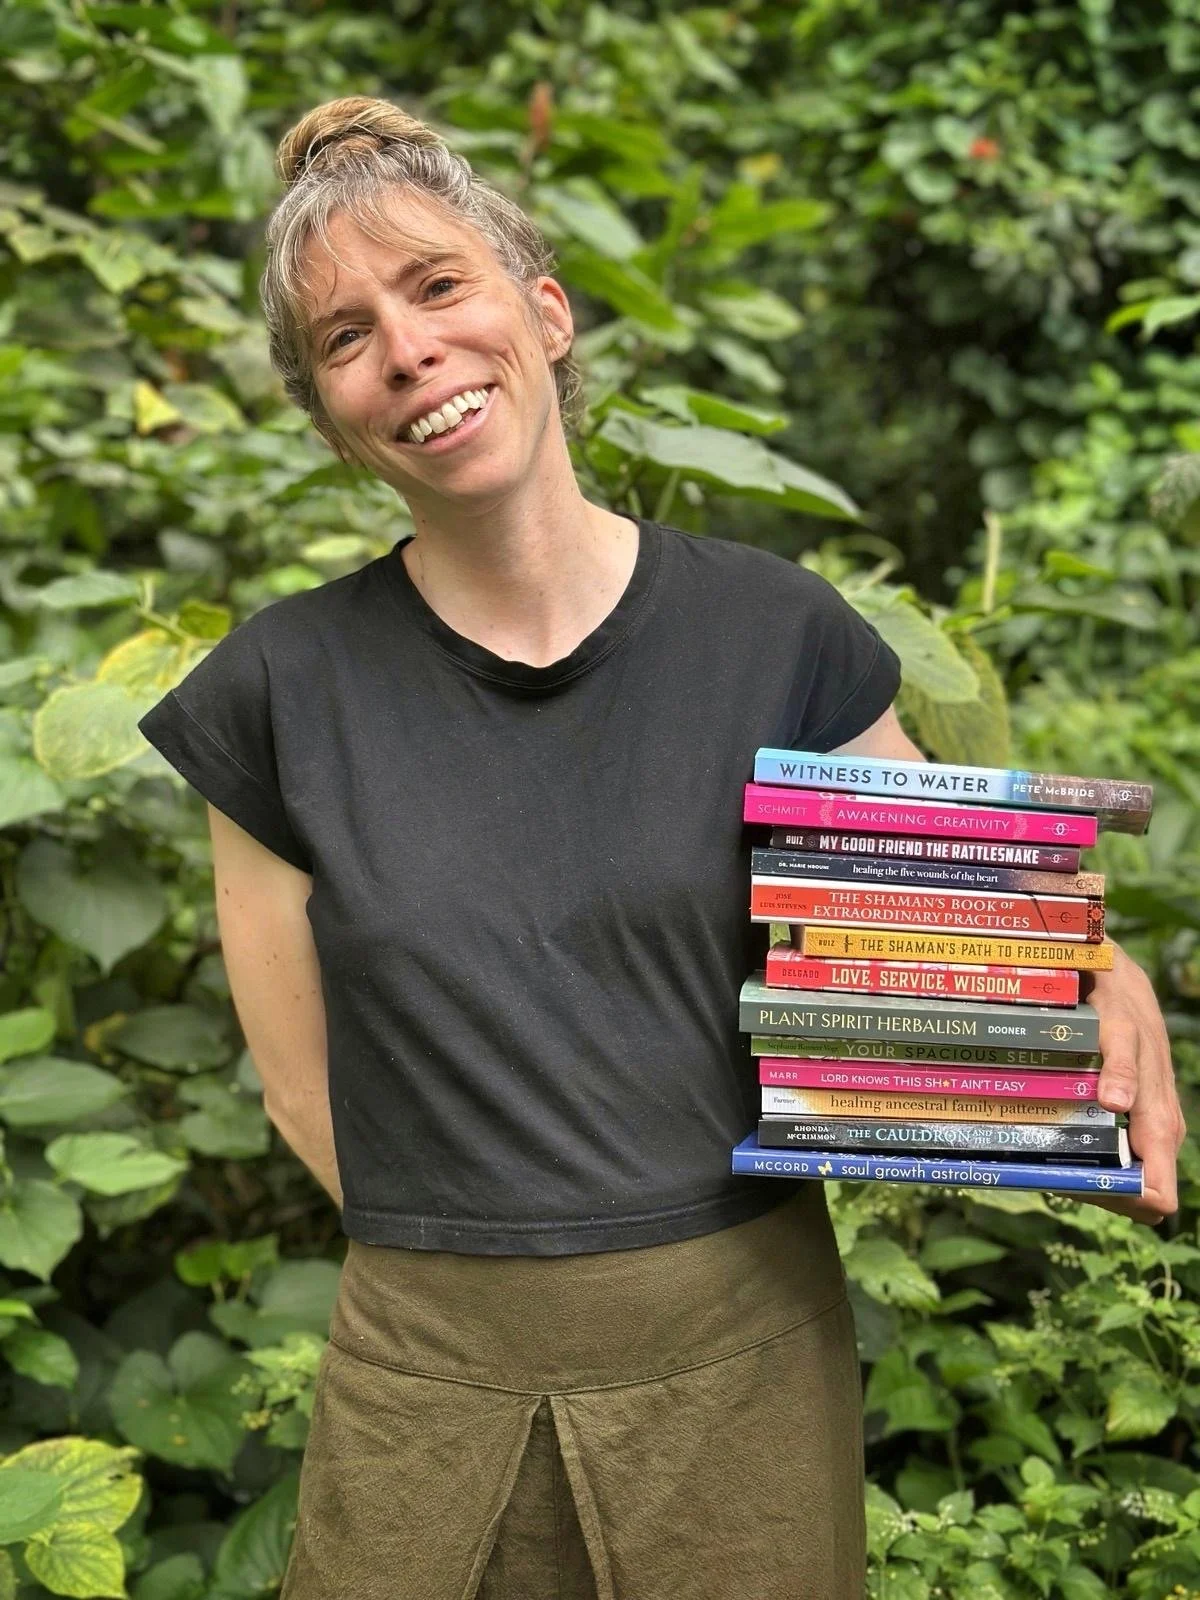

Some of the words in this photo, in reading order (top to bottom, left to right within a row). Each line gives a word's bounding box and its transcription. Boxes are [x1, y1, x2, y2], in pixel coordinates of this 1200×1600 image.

[780, 763, 871, 784] WITNESS
[882, 771, 907, 786] TO
[919, 774, 988, 793] WATER
[1013, 783, 1040, 794] PETE
[1045, 786, 1095, 798] McBRIDE
[758, 804, 808, 816] SCHMITT
[836, 809, 926, 826] AWAKENING
[934, 815, 1010, 830] CREATIVITY
[786, 835, 804, 845] RUIZ
[820, 835, 837, 850] MY
[841, 837, 875, 853] GOOD
[879, 839, 922, 856] FRIEND
[926, 842, 949, 858] THE
[951, 844, 1040, 865] RATTLESNAKE
[852, 864, 884, 877] healing
[885, 867, 899, 877] the
[900, 867, 916, 877] five
[917, 869, 949, 880] wounds
[950, 871, 962, 880] of
[961, 871, 975, 881] the
[976, 873, 999, 883] heart
[829, 891, 860, 904] THE
[864, 894, 945, 910] SHAMAN'S
[951, 898, 997, 912] BOOK
[1001, 901, 1015, 910] OF
[813, 905, 943, 924] EXTRAORDINARY
[944, 913, 1030, 928] PRACTICES
[818, 939, 835, 947] RUIZ
[861, 938, 884, 951] THE
[889, 940, 956, 955] SHAMAN'S
[961, 943, 992, 957] PATH
[998, 945, 1012, 958] TO
[1017, 946, 1074, 960] FREEDOM
[782, 968, 820, 979] DELGADO
[832, 967, 874, 987] LOVE,
[879, 970, 949, 991] SERVICE,
[954, 975, 1022, 995] WISDOM
[760, 1010, 817, 1027] PLANT
[821, 1013, 873, 1030] SPIRIT
[878, 1016, 977, 1036] HERBALISM
[987, 1025, 1027, 1036] DOONER
[846, 1044, 896, 1057] YOUR
[904, 1047, 997, 1062] SPACIOUS
[1007, 1051, 1050, 1065] SELF
[769, 1071, 798, 1080] MARR
[821, 1073, 849, 1084] LORD
[851, 1075, 890, 1086] KNOWS
[892, 1076, 921, 1087] THIS
[960, 1079, 991, 1090] AIN'T
[994, 1080, 1026, 1092] EASY
[773, 1096, 796, 1104] Farmer
[830, 1095, 882, 1112] healing
[885, 1099, 947, 1112] ancestral
[952, 1101, 996, 1117] family
[1000, 1103, 1058, 1117] patterns
[794, 1125, 829, 1133] RHONDA
[847, 1128, 871, 1138] THE
[875, 1128, 971, 1143] CAULDRON
[972, 1129, 993, 1137] AND
[974, 1137, 992, 1145] THE
[754, 1160, 809, 1172] MCCORD
[841, 1160, 870, 1176] soul
[874, 1163, 926, 1180] growth
[931, 1165, 1001, 1185] astrology
